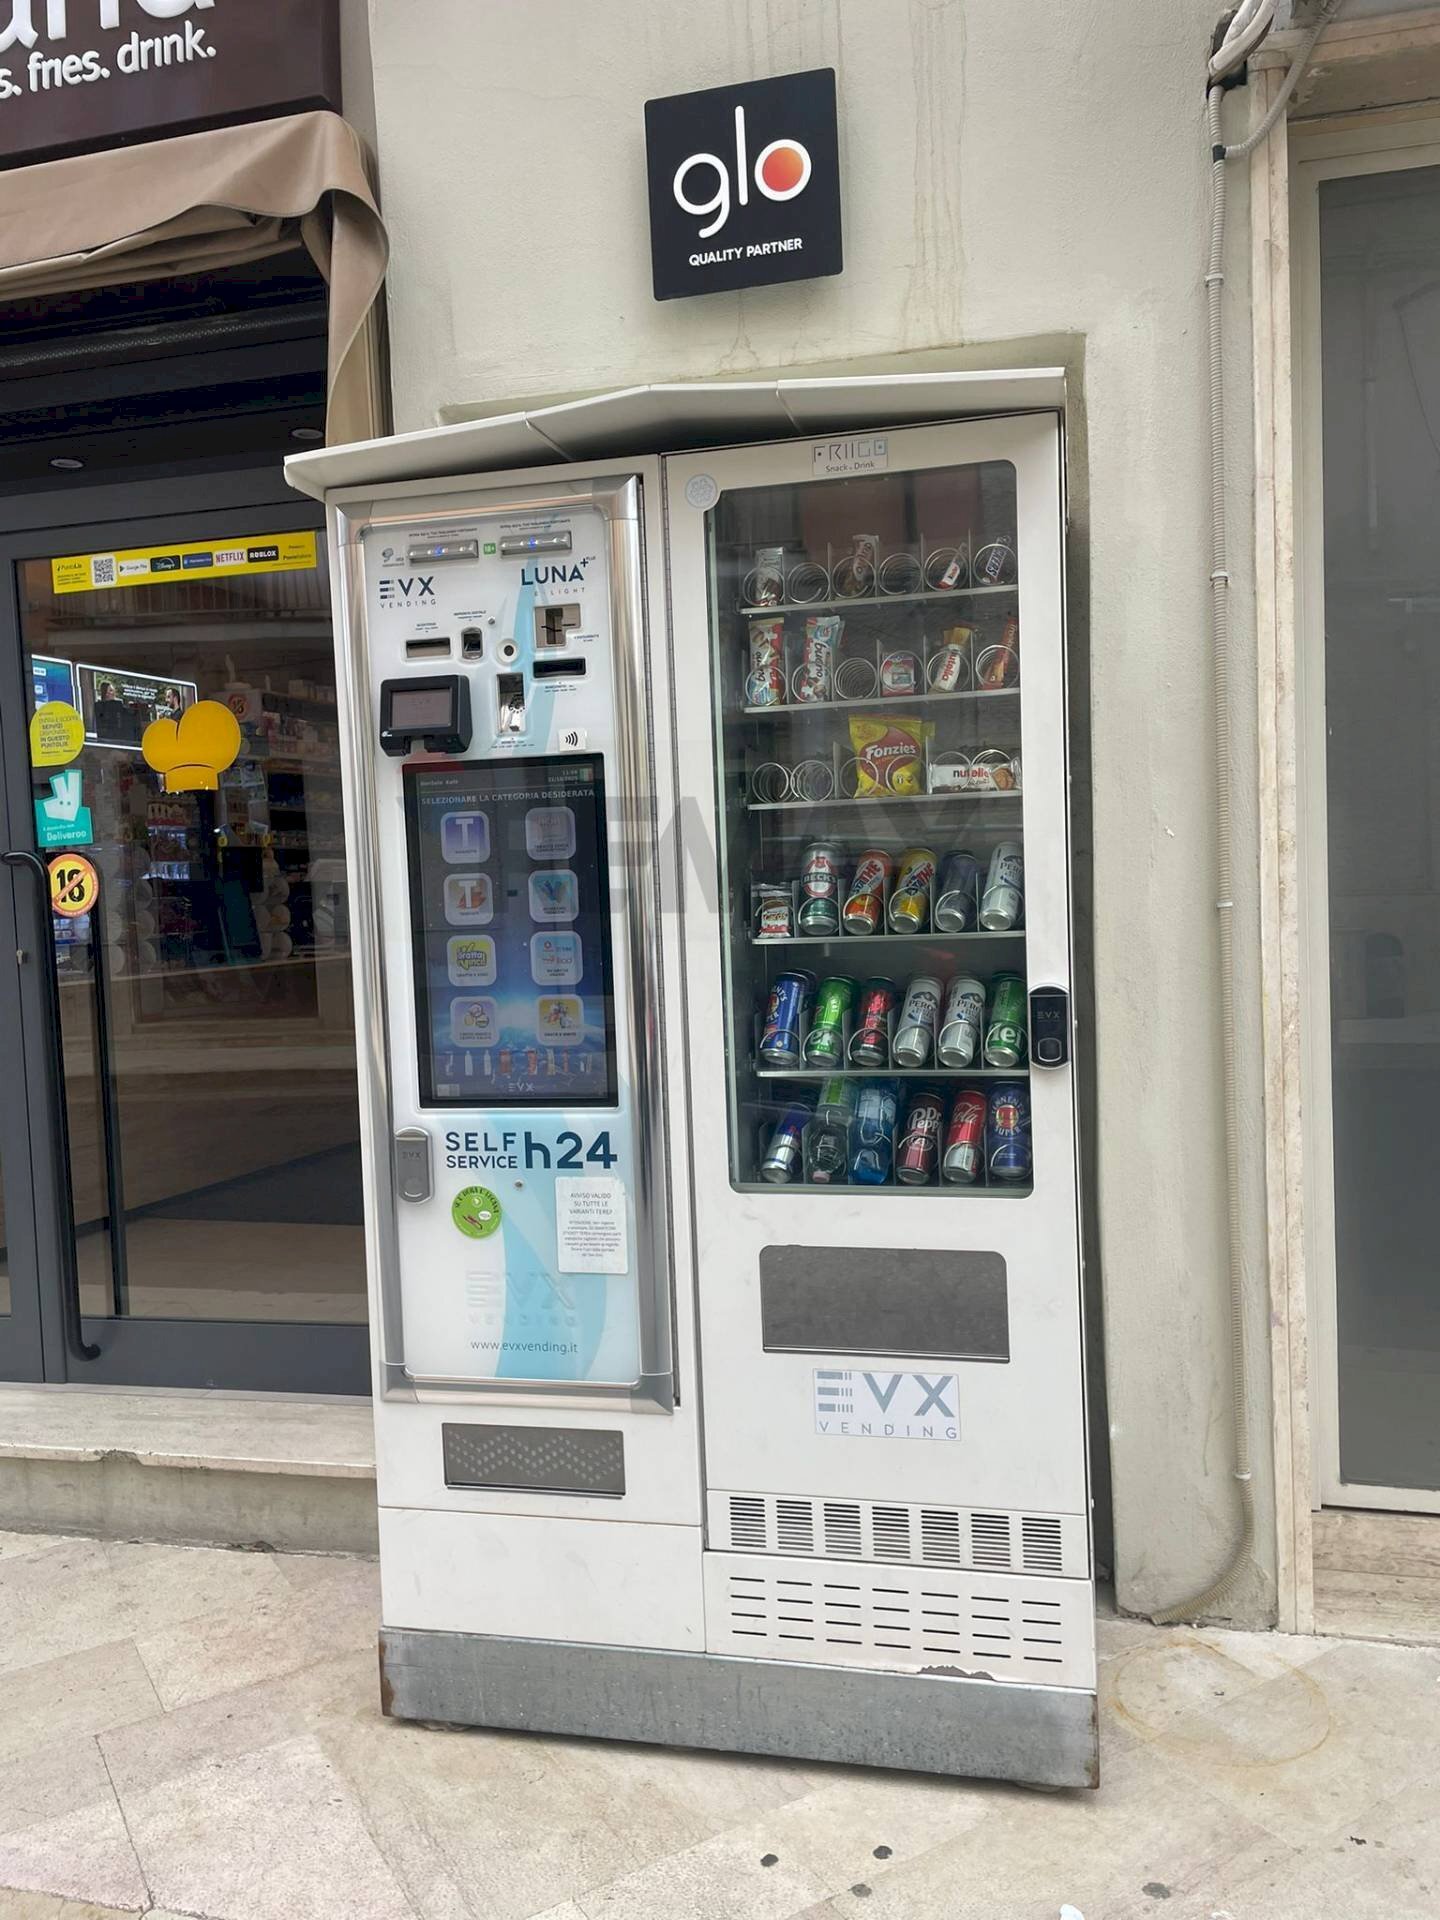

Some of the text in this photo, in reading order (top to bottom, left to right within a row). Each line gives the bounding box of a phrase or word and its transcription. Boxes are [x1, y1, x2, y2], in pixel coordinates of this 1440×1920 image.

[117, 20, 216, 74] drink.
[673, 105, 812, 239] glo
[688, 238, 803, 267] QUALITY PARTNER
[826, 460, 876, 473] Snack Drink
[215, 551, 245, 563] NETFLIX
[249, 549, 277, 559] ROBLOX
[379, 576, 435, 600] EVX
[380, 599, 437, 609] VENDING
[865, 743, 916, 760] Fonzies
[421, 789, 595, 805] SELEZIONARE LA CATEGORIA DESIDERATA
[46, 830, 87, 841] Deliveroo
[56, 868, 85, 903] 18
[445, 1131, 517, 1152] SELF
[524, 1131, 618, 1169] h24
[446, 1155, 518, 1169] SERVICE
[470, 1340, 578, 1355] www.evxvending.it
[816, 1371, 956, 1418] EVX
[818, 1421, 958, 1440] VENDING
